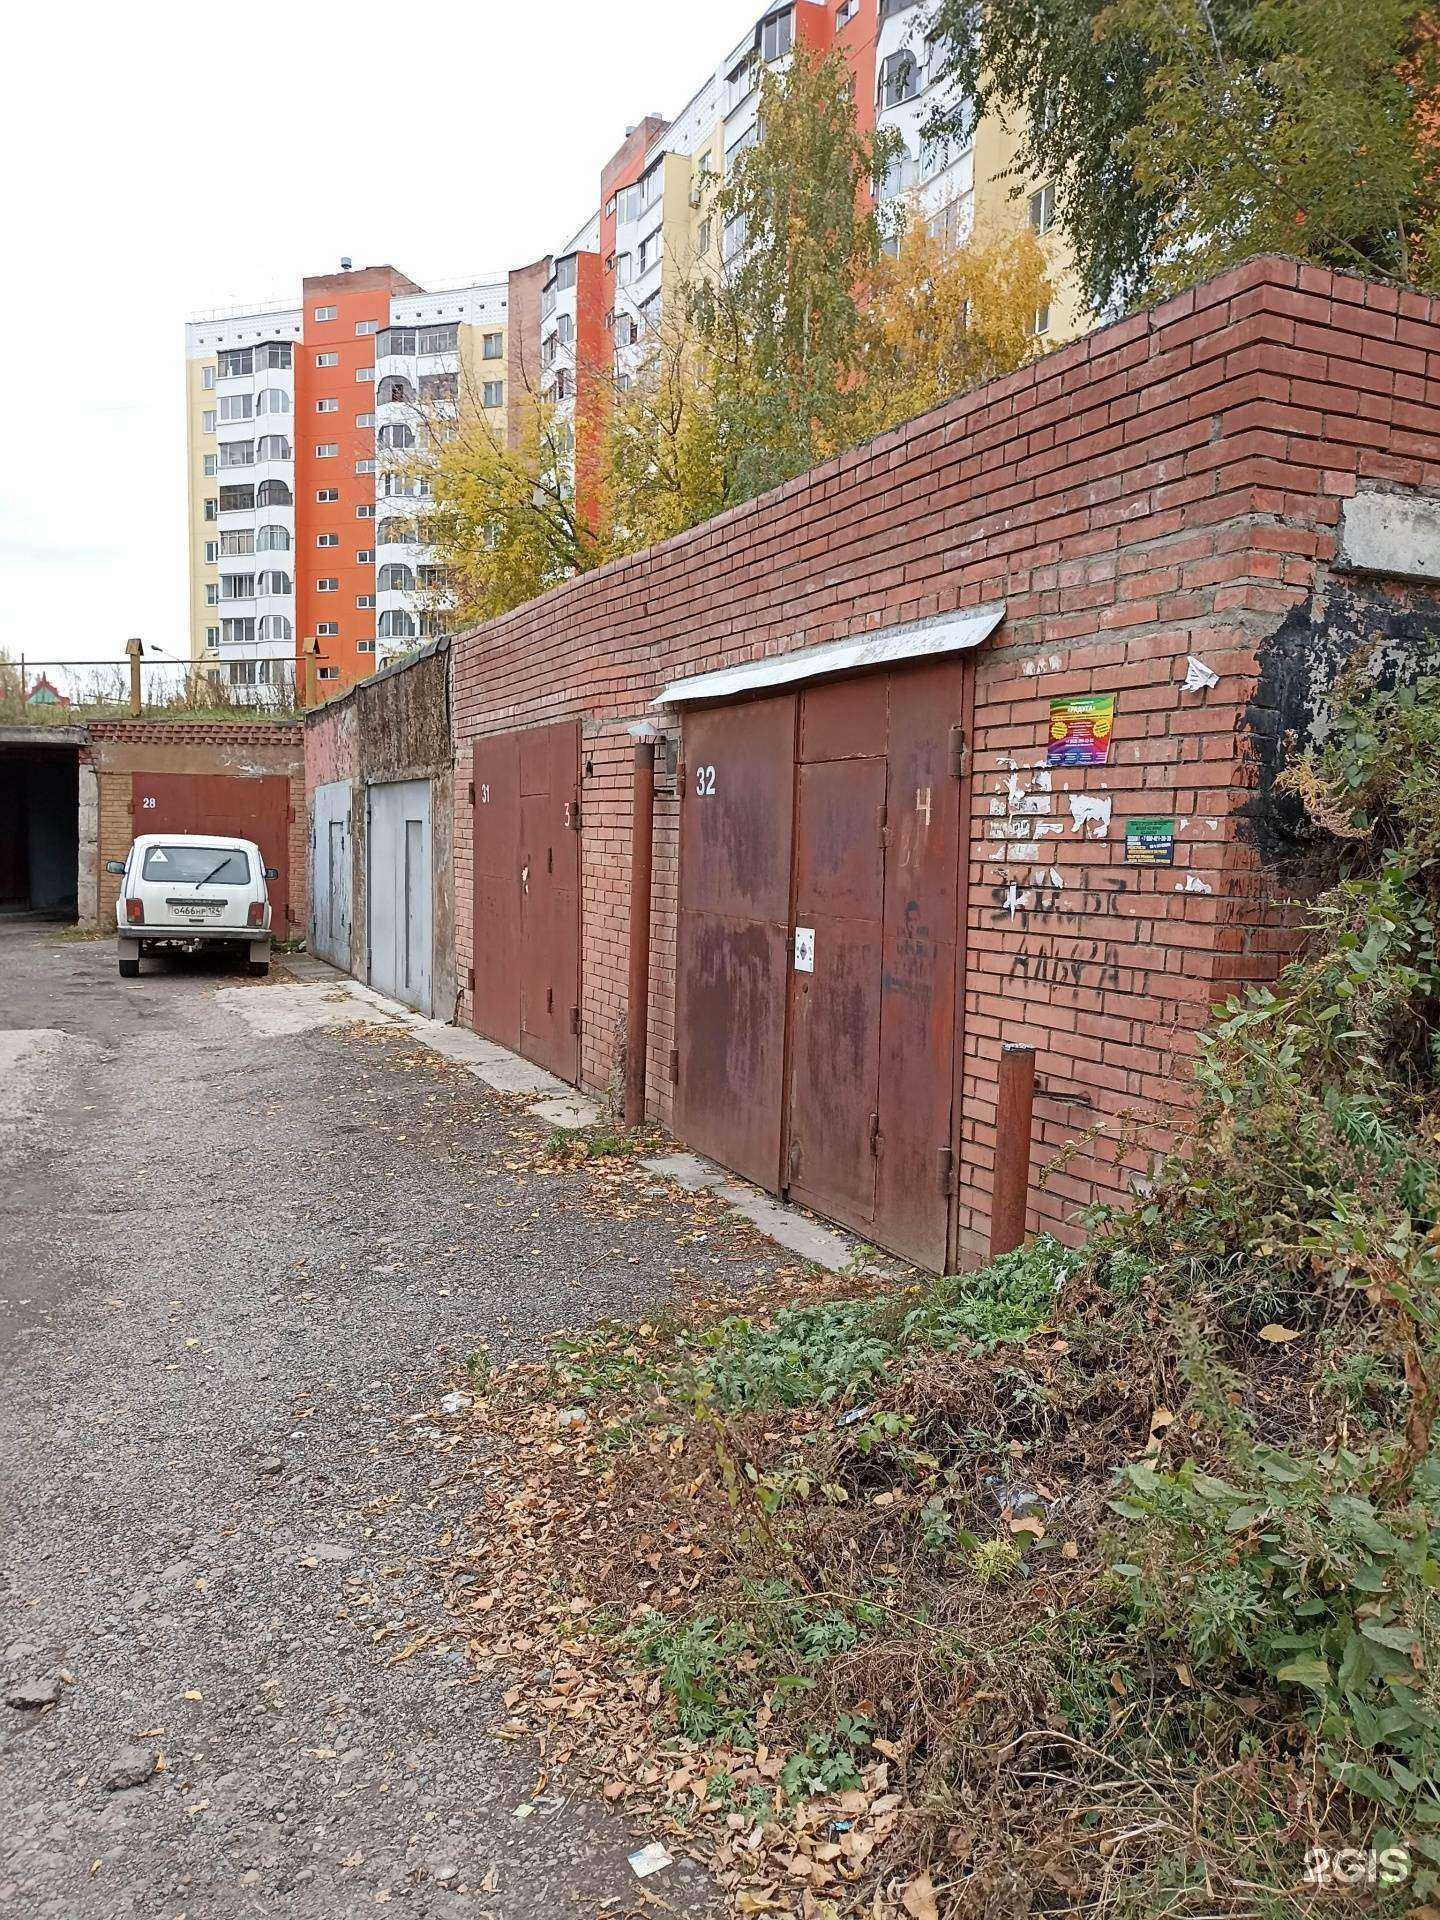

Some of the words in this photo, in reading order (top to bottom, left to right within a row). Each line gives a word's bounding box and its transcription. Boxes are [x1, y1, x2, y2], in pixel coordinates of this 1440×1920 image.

[696, 766, 716, 796] 32
[143, 797, 156, 809] 28
[481, 783, 490, 803] 31
